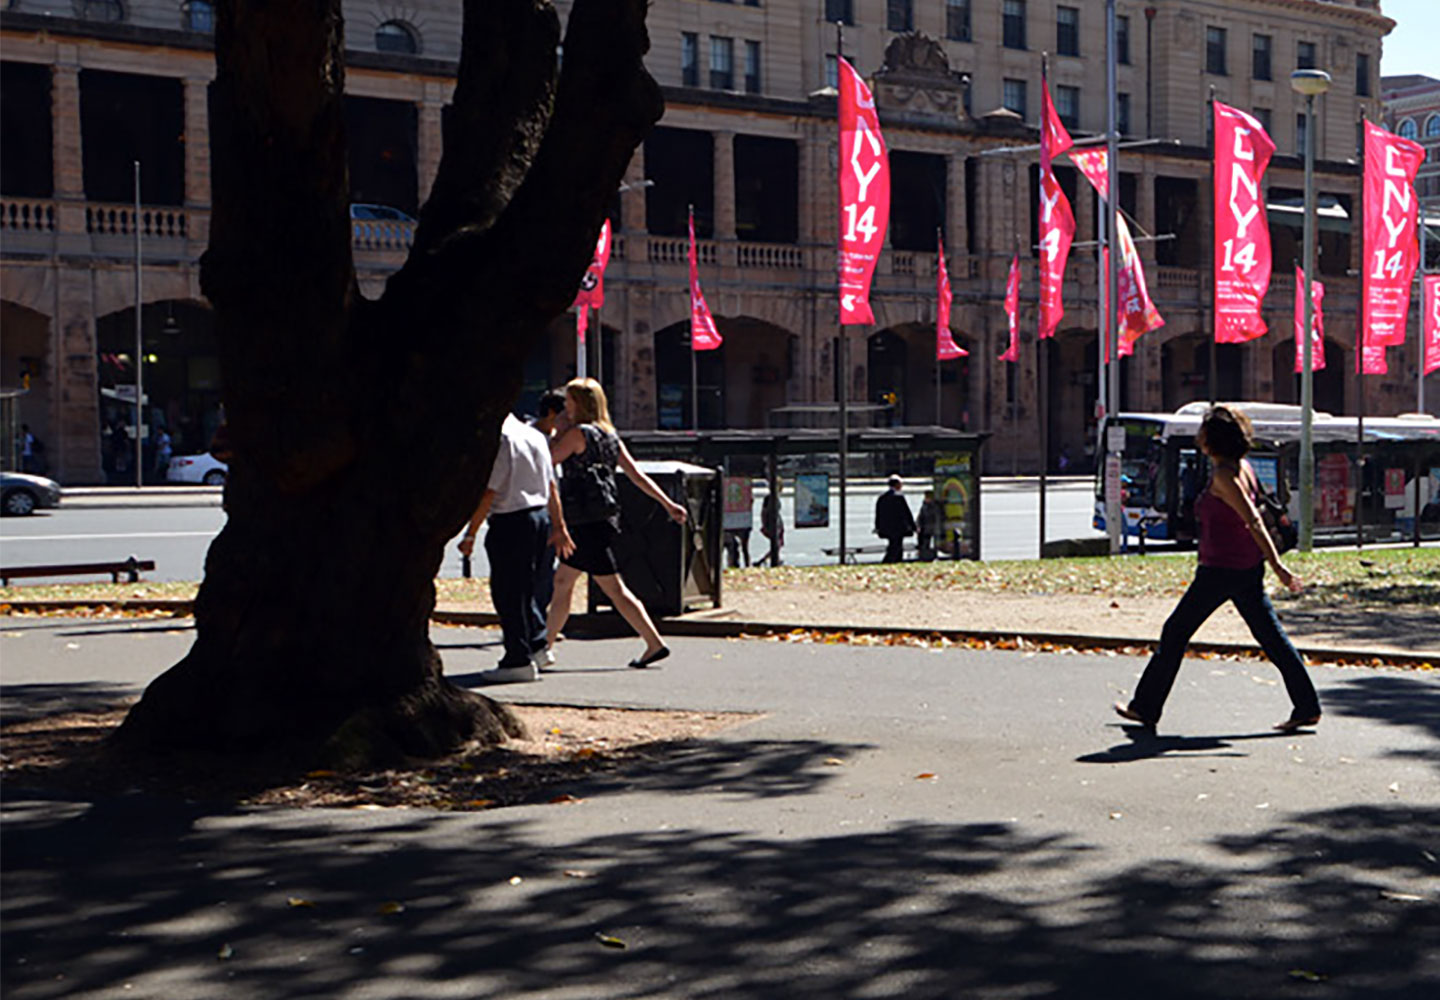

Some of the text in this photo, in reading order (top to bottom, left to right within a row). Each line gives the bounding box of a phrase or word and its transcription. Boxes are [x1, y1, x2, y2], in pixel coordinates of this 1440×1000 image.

[1230, 126, 1260, 238] CNY
[1382, 144, 1411, 249] CNY
[843, 203, 878, 243] 14
[1220, 238, 1258, 274] 14
[1370, 249, 1403, 280] 14
